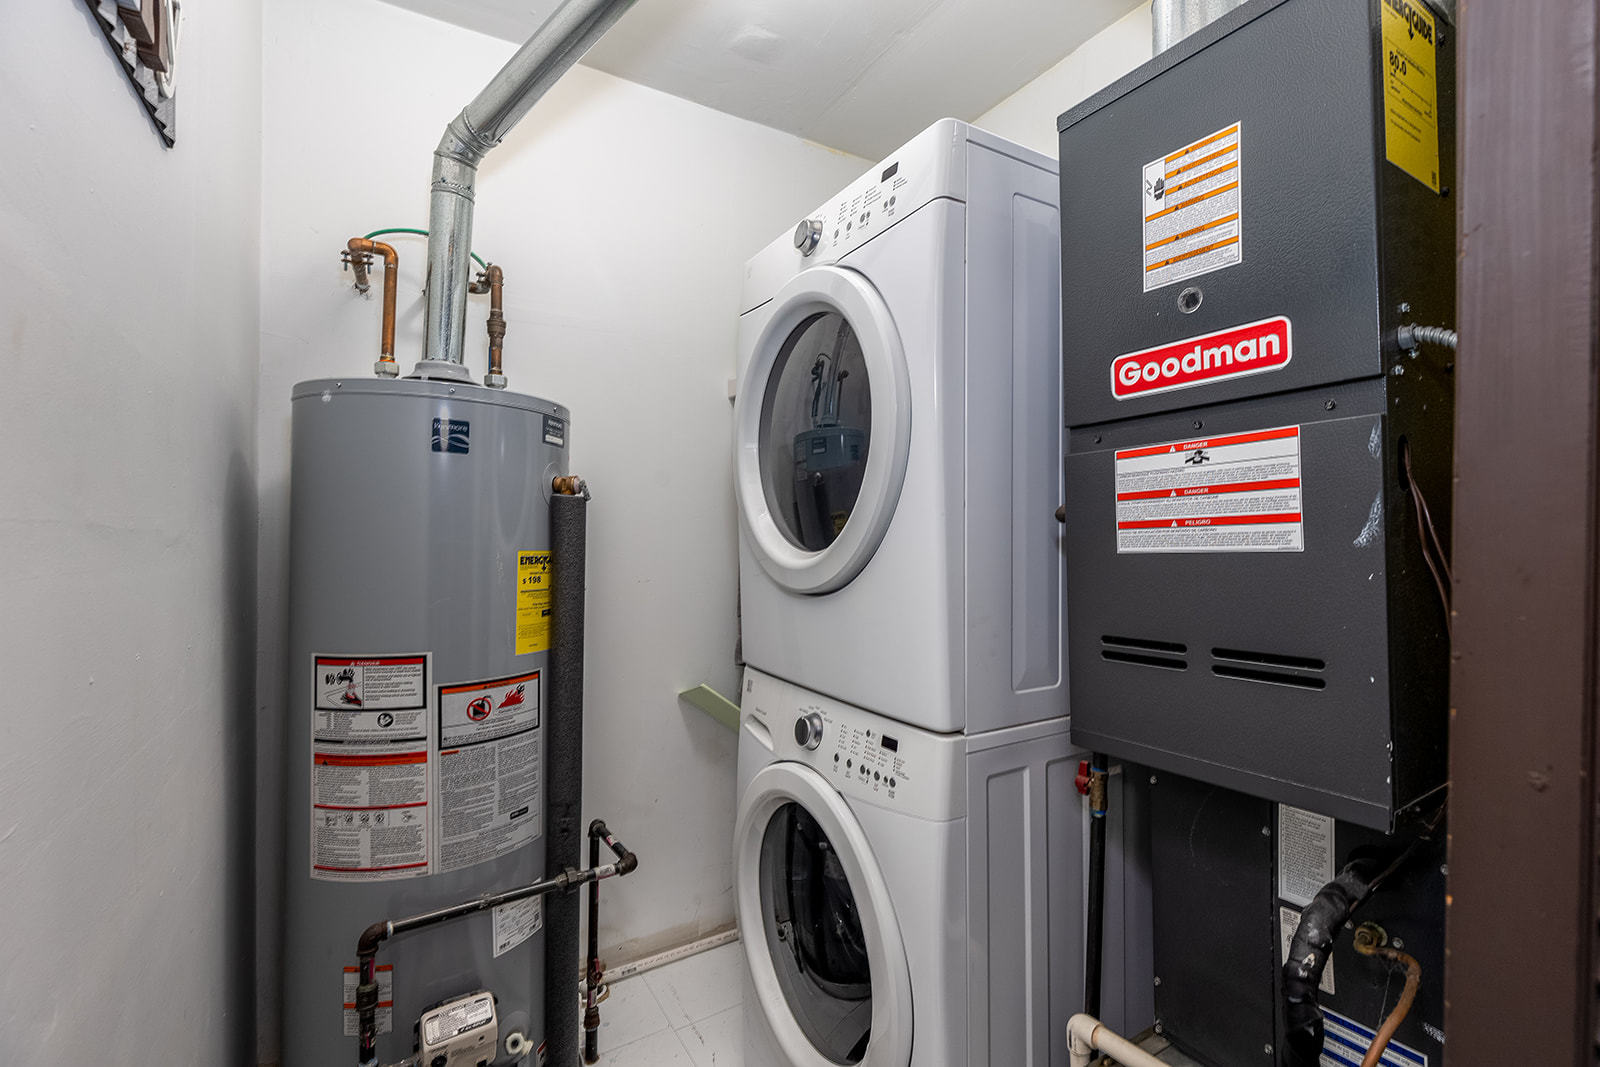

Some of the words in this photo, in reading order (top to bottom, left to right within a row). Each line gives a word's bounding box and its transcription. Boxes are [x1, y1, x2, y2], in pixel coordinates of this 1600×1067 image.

[1118, 333, 1281, 387] Goodman
[1183, 441, 1209, 450] DANGER
[1184, 487, 1209, 496] DANGER
[1184, 518, 1211, 526] PELIGRO
[528, 575, 542, 584] 198
